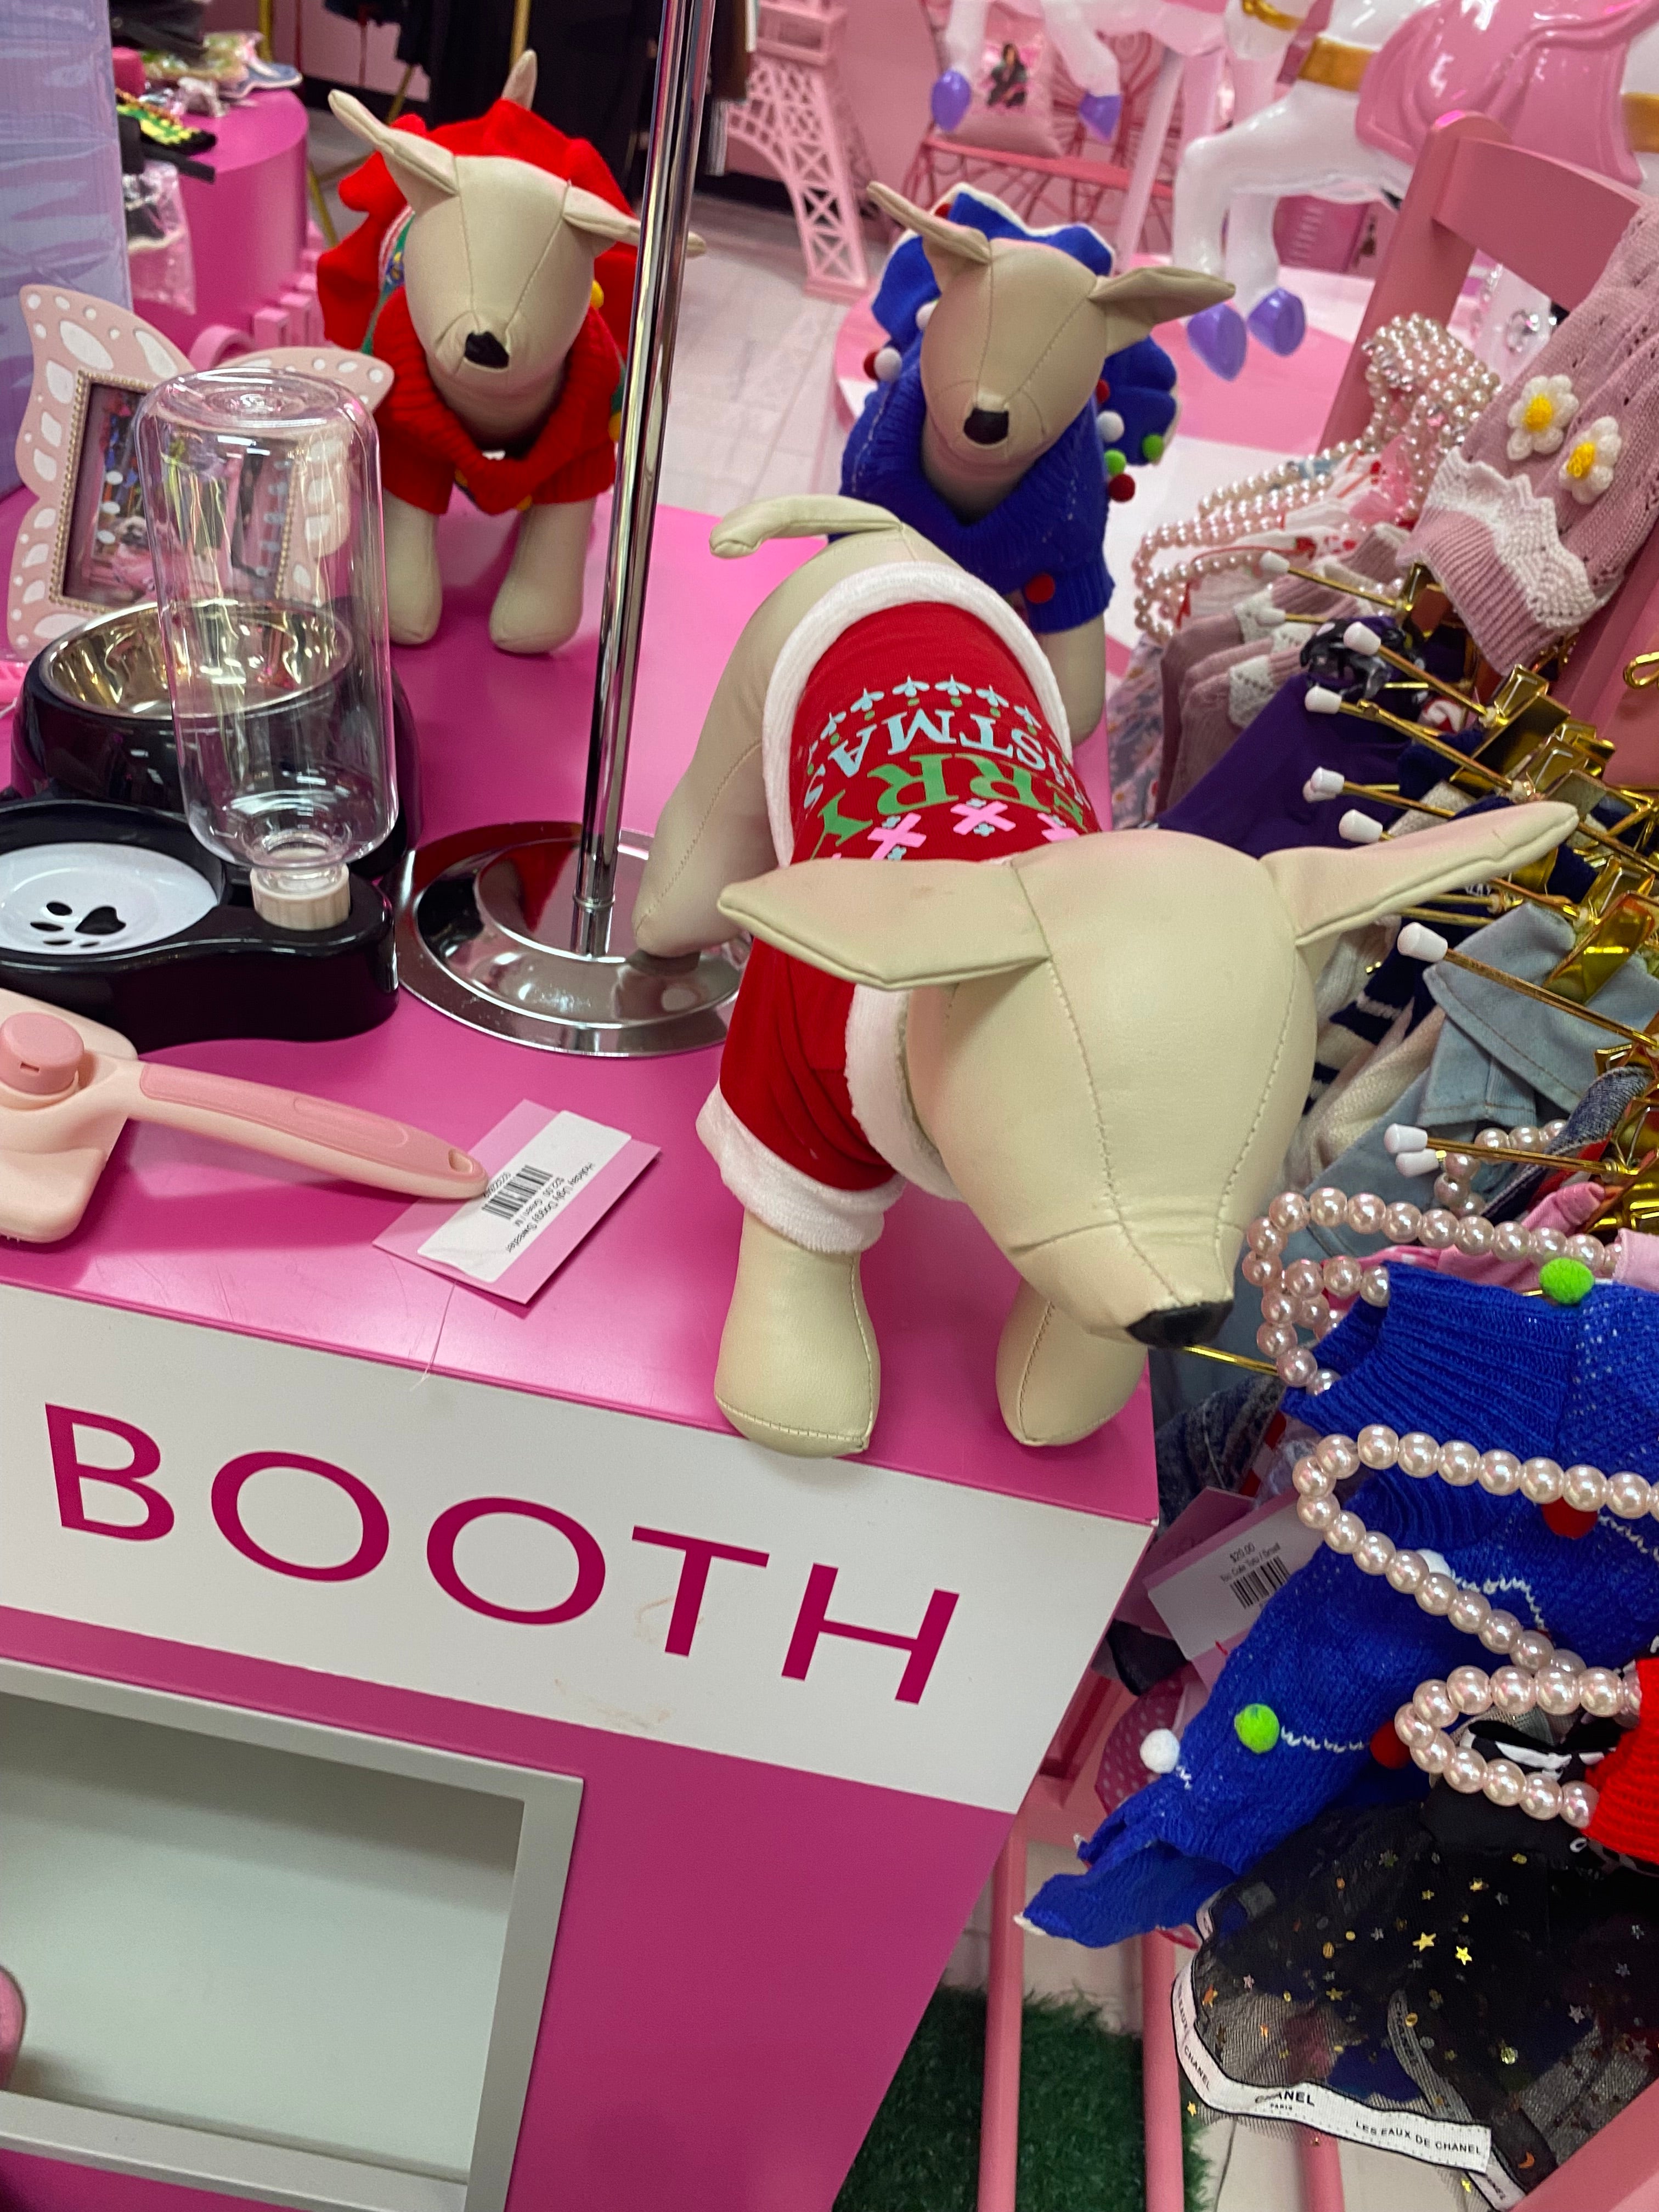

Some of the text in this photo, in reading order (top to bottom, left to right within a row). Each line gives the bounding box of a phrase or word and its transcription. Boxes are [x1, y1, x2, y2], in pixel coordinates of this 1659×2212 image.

[803, 708, 1091, 820] RISTMAS
[810, 753, 1089, 860] ERRY
[44, 1402, 960, 1705] BOOTH
[1184, 2045, 1210, 2091] CHANEL
[1356, 2119, 1481, 2155] LES EAUX DE CHANEL
